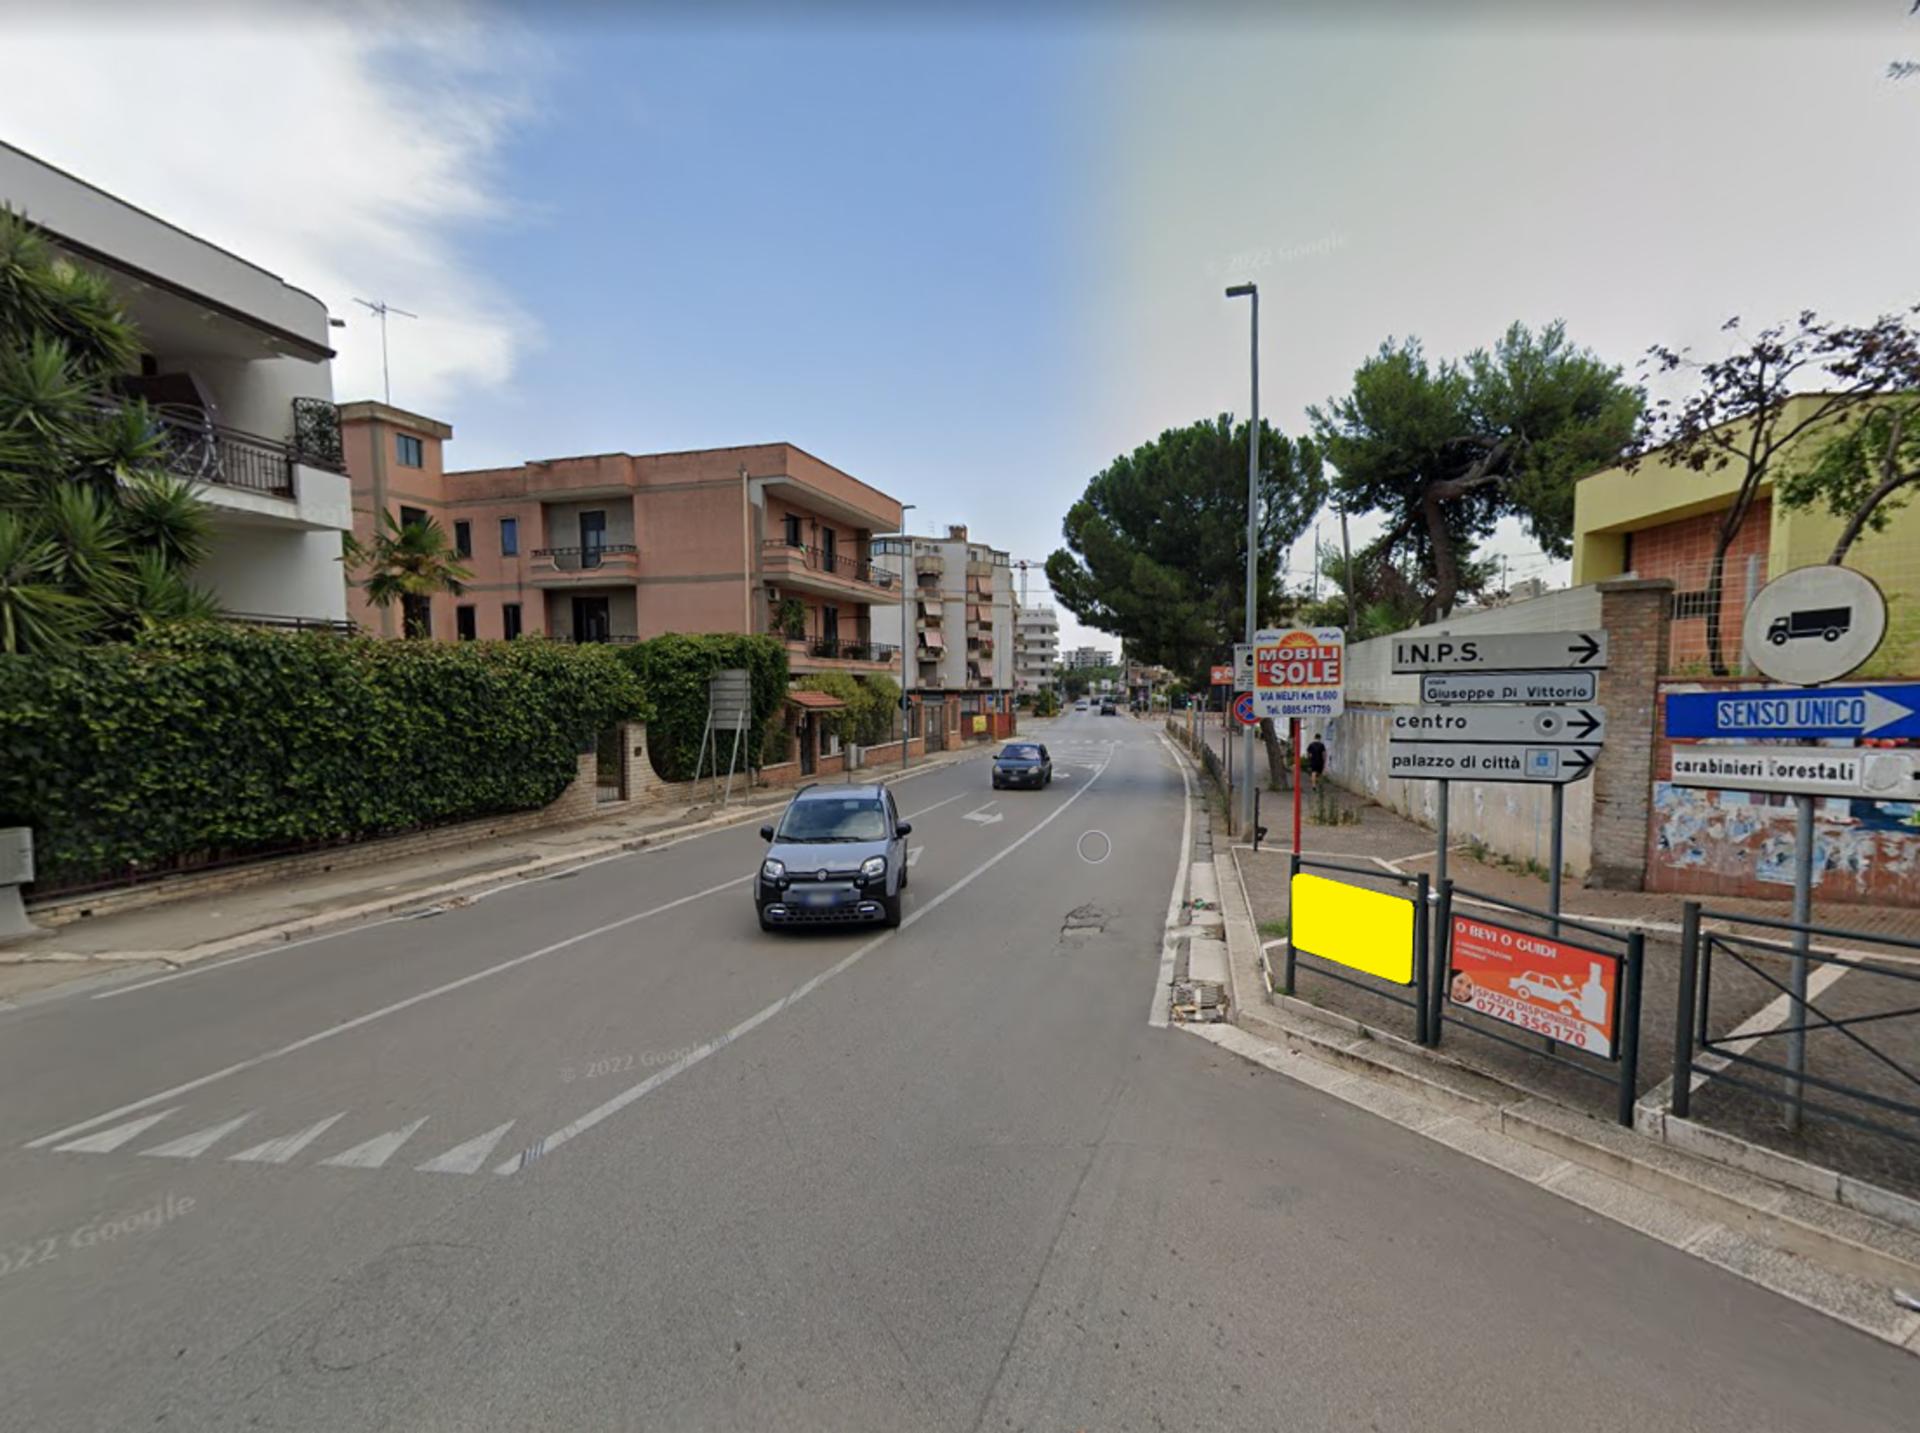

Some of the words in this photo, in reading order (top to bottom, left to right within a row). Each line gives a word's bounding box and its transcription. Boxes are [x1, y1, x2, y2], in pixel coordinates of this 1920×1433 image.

[1259, 647, 1338, 661] MOBILI
[1397, 642, 1484, 664] I.N.P.S.
[1259, 663, 1269, 673] IL
[1270, 662, 1338, 684] SOLE
[1259, 691, 1274, 701] VIA
[1301, 690, 1314, 701] Km
[1427, 687, 1495, 700] Giuseppe
[1502, 687, 1517, 698] Di
[1527, 686, 1588, 698] Vittorio
[1395, 713, 1467, 729] centro
[1719, 700, 1789, 726] SENSO
[1795, 698, 1866, 725] UNICO
[1392, 755, 1455, 768] palazzo
[1460, 755, 1476, 769] di
[1482, 754, 1520, 770] città
[1674, 758, 1762, 776] carabinieri
[1455, 922, 1467, 934] O
[1469, 925, 1498, 943] BEVI
[1500, 933, 1512, 947] O
[1516, 938, 1557, 959] GUIDI
[1474, 986, 1514, 1007] SPAZIO
[1516, 1000, 1587, 1032] DISPONIBILE
[1475, 998, 1515, 1021] 0774
[1520, 1012, 1587, 1047] 356170
